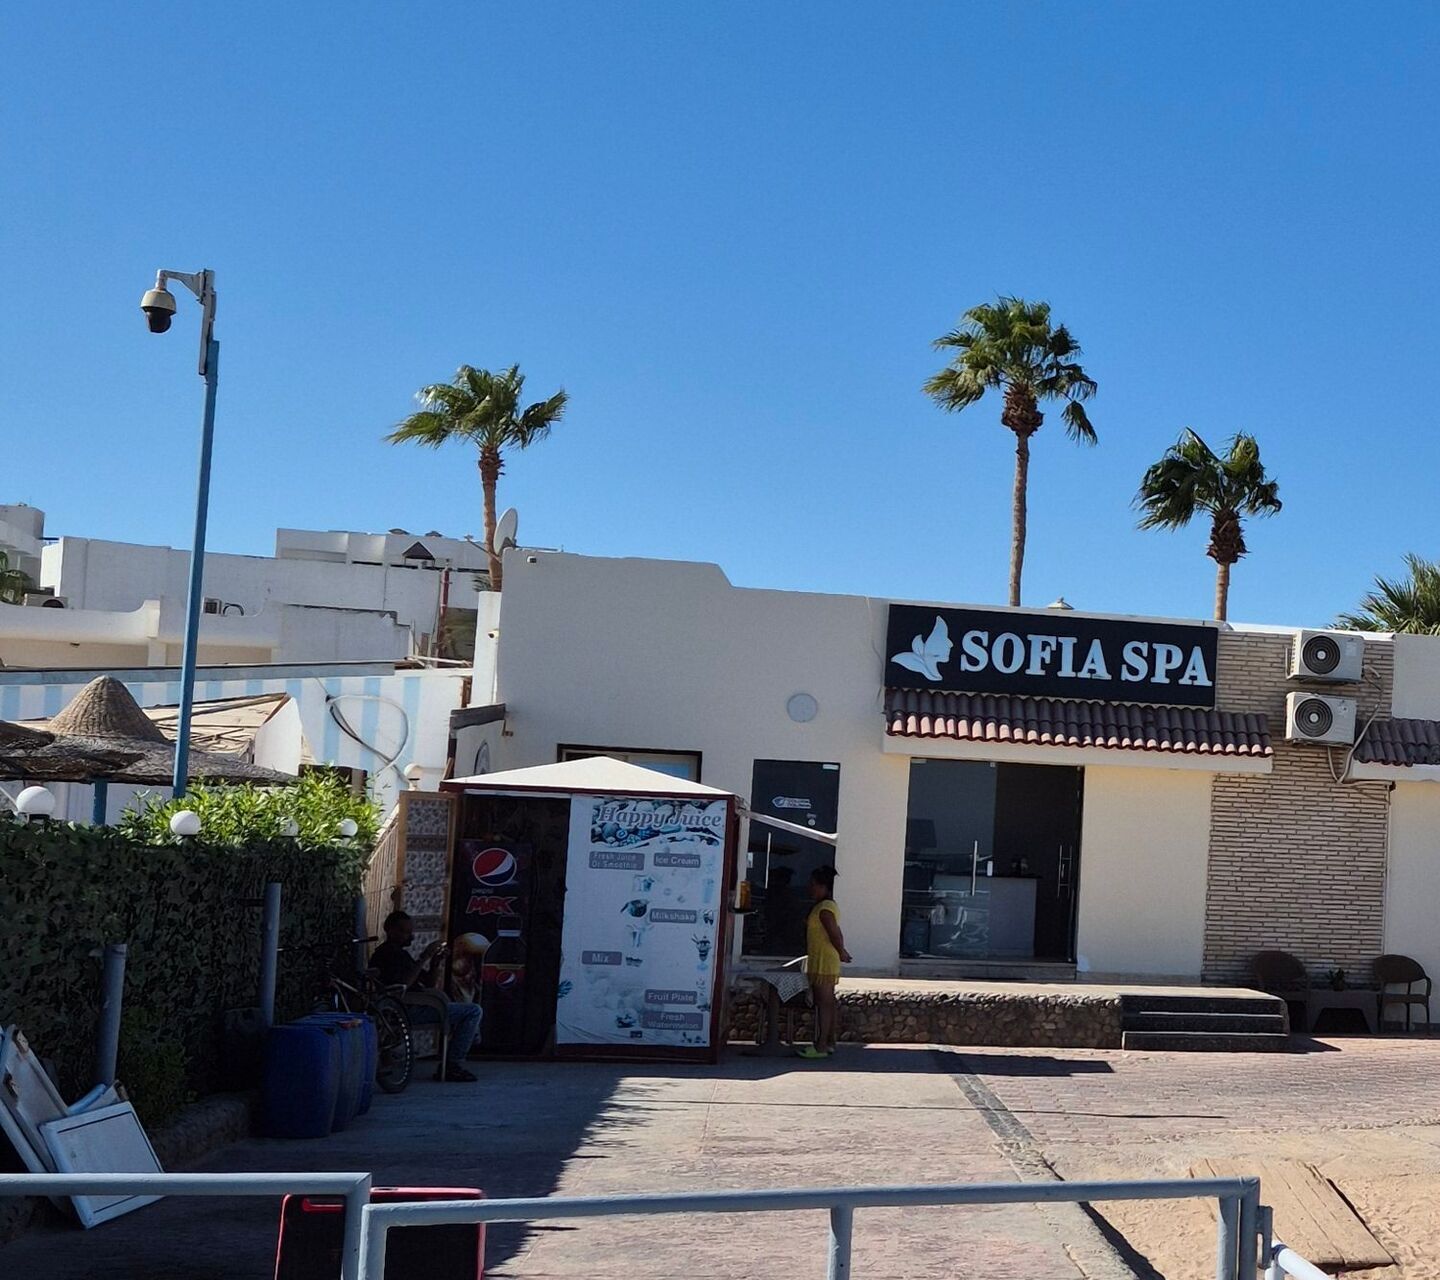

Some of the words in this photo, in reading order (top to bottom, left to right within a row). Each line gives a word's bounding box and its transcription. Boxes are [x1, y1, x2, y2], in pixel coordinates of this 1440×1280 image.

[960, 629, 1112, 681] SOFIA
[1120, 640, 1213, 687] SPA
[600, 805, 666, 828] Happy
[668, 809, 722, 827] Juice
[655, 853, 667, 864] Ice
[670, 855, 700, 866] Cream
[651, 911, 696, 921] Milkshake
[591, 953, 609, 964] Mix
[647, 992, 669, 1001] Fruit
[671, 993, 694, 1002] Plate
